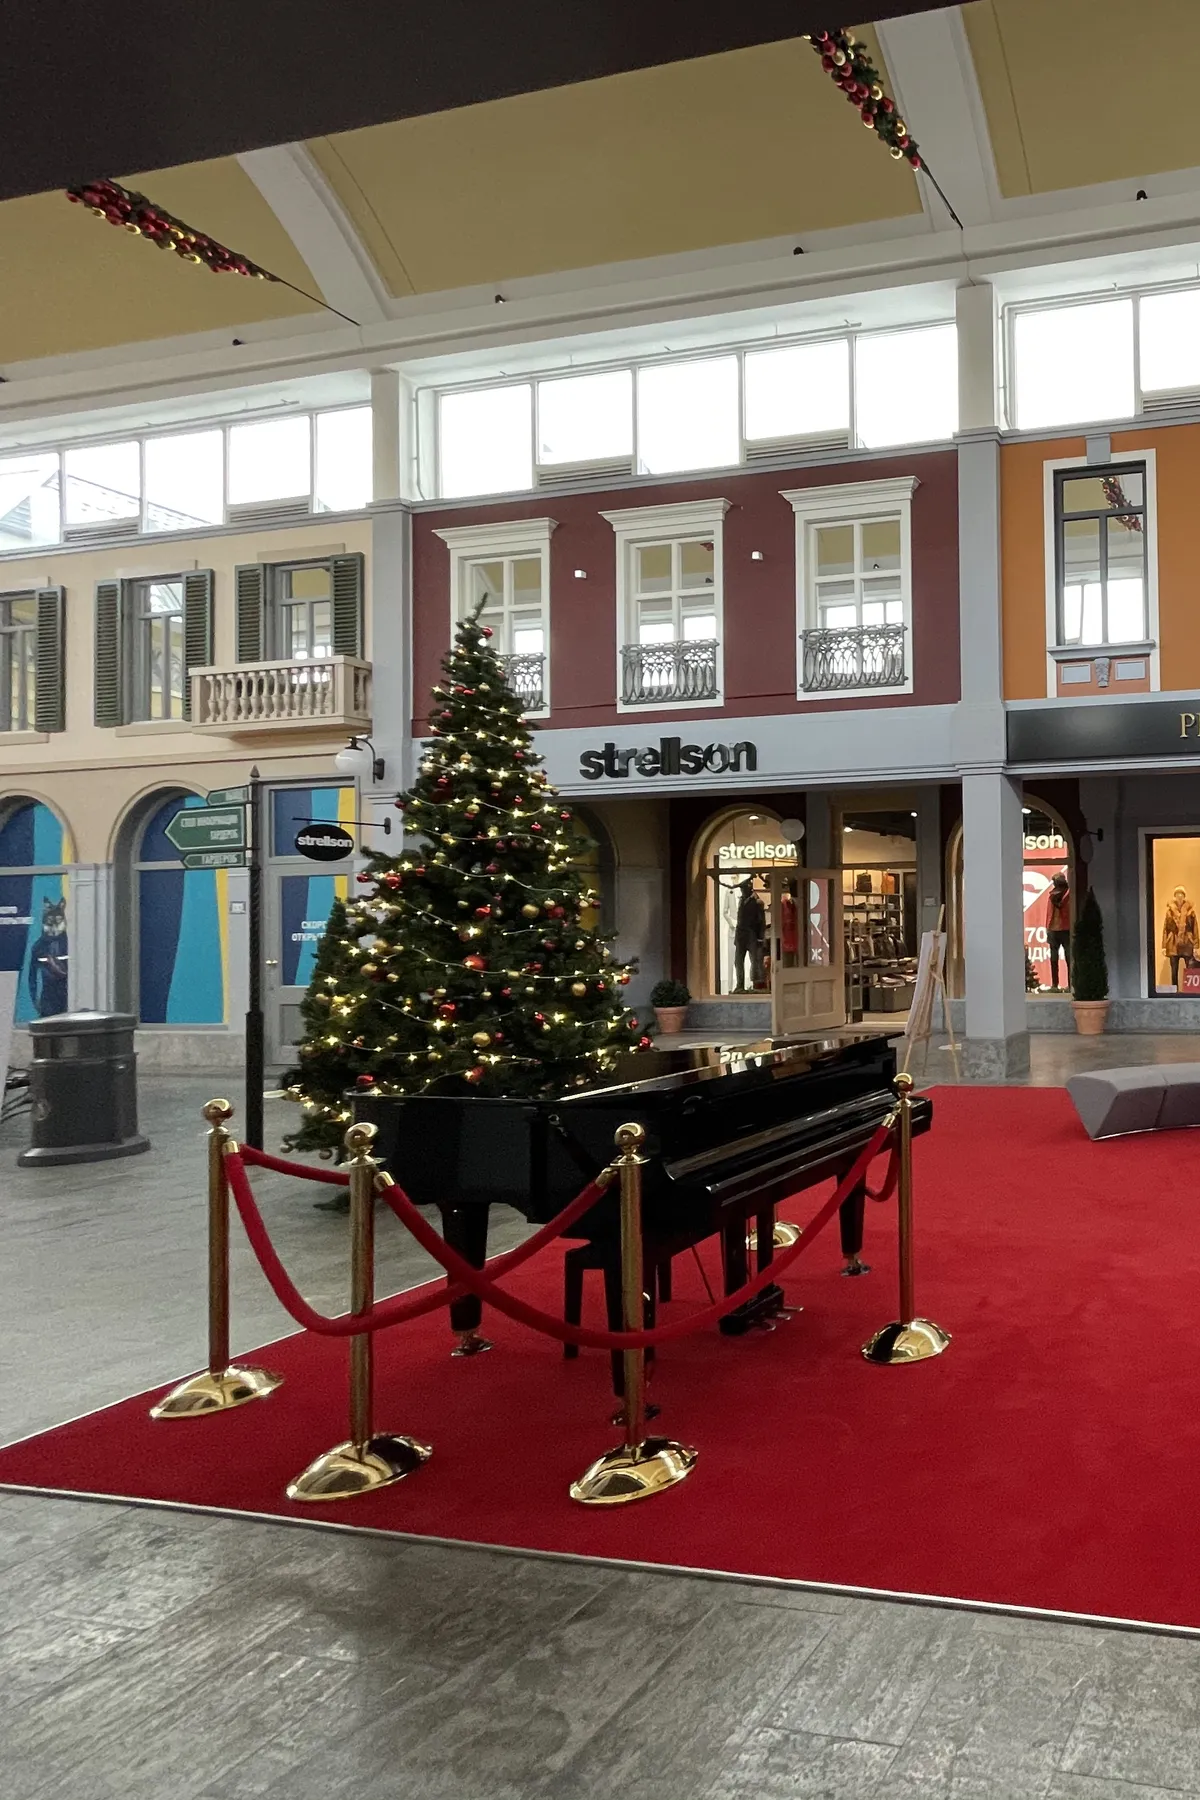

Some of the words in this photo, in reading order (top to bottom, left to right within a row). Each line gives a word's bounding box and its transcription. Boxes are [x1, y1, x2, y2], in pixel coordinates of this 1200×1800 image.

[580, 737, 757, 780] strellson
[297, 835, 353, 847] strellson
[719, 841, 797, 859] strellson
